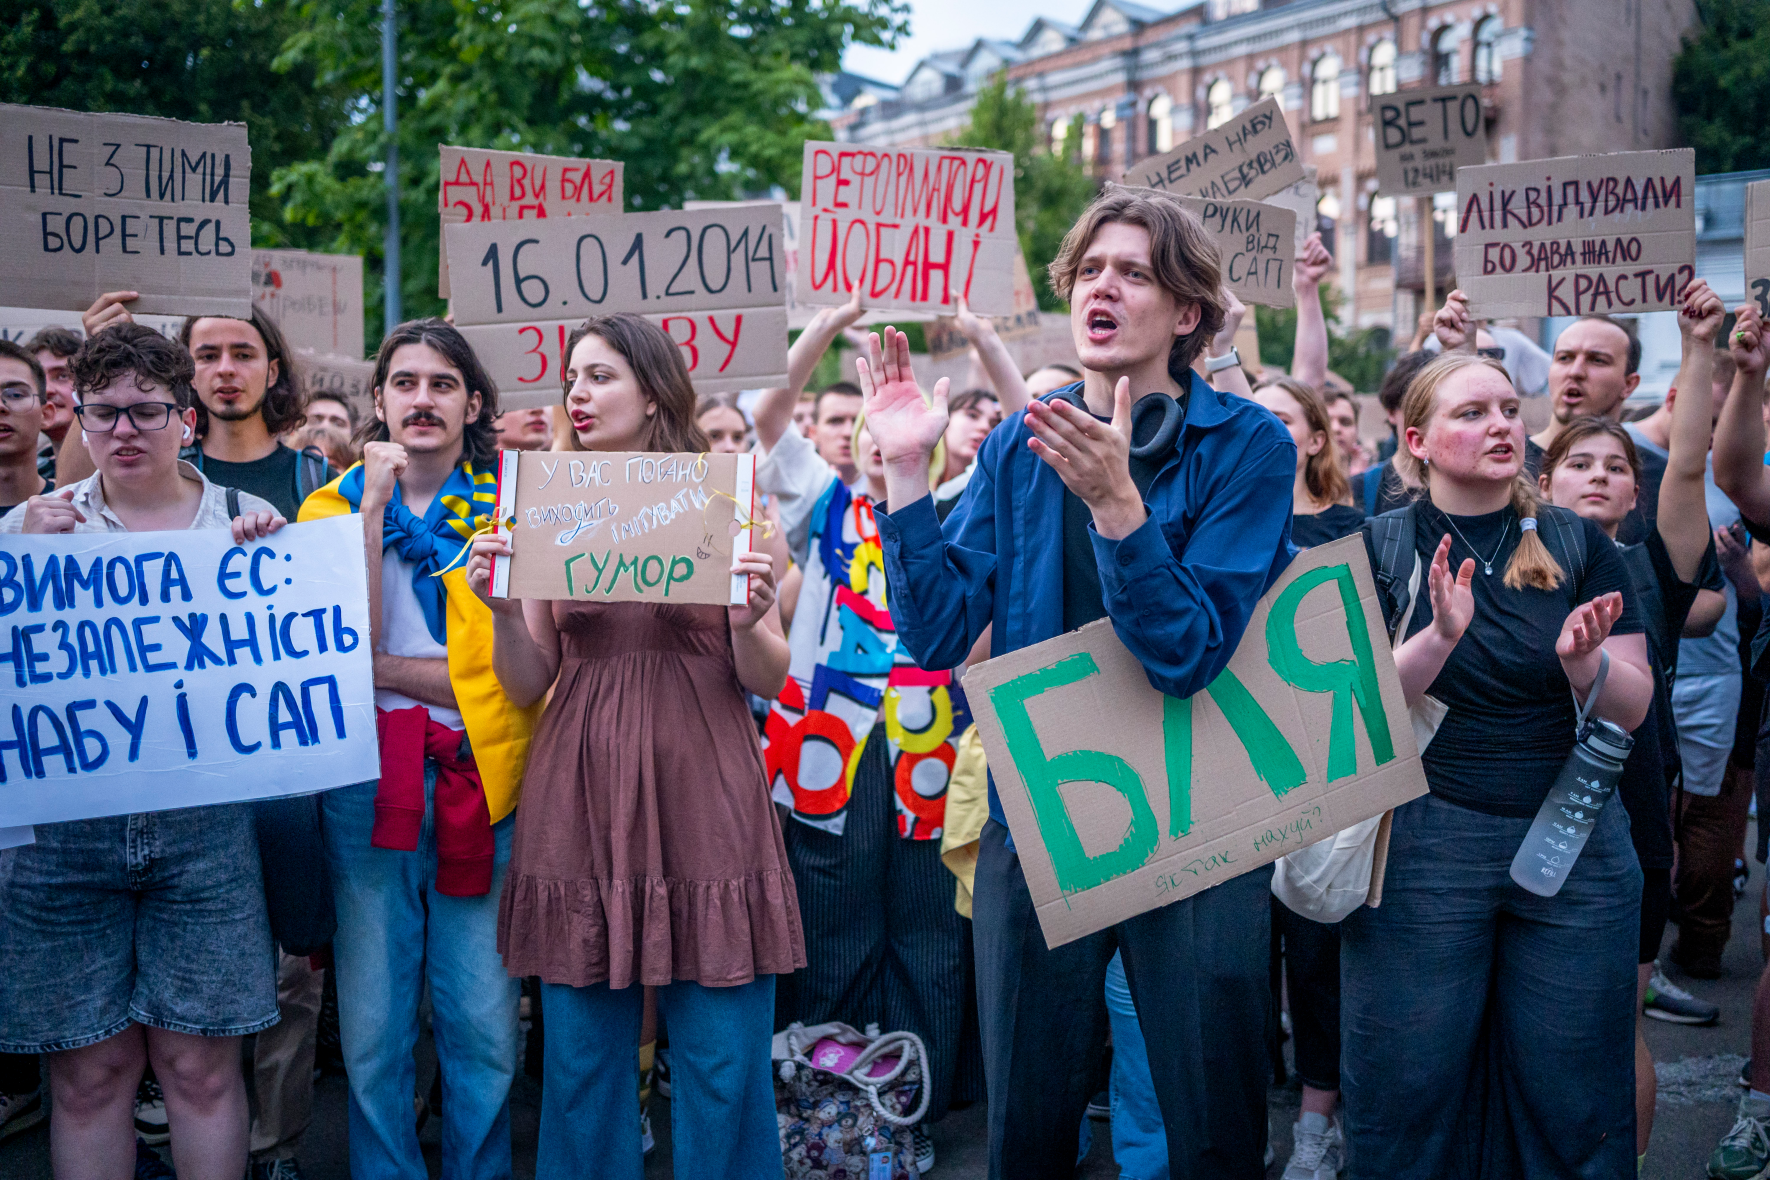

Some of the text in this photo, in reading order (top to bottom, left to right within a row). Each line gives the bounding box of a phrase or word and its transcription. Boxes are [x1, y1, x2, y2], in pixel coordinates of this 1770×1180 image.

[1225, 110, 1273, 152] НАБУ
[1381, 93, 1480, 152] ВЕТО
[28, 135, 82, 198] НЕ
[135, 144, 231, 205] ТИМИ
[444, 156, 615, 207] ДА ВИ БЛЯ
[811, 149, 1004, 233] РЕФОРМАТОРИ
[1203, 202, 1260, 235] РУКИ
[1459, 175, 1682, 234] ЛІКВІДУВАЛИ
[41, 212, 235, 257] БОРЕТЕСЬ
[810, 208, 981, 306] ЙОБАНІ
[1483, 242, 1518, 275] БО
[480, 223, 779, 314] 16.01.2014
[1228, 252, 1284, 289] САП
[1547, 264, 1695, 317] КРАСТИ?
[517, 314, 743, 383] ЗВУ
[538, 459, 559, 490] У
[568, 460, 611, 488] ВАС
[626, 455, 709, 483] ПОГАНО
[0, 546, 292, 617] ВИМОГА ЄС:
[565, 549, 694, 597] ГУМОР
[0, 695, 149, 783] НАБУ
[225, 674, 347, 755] САП
[986, 561, 1396, 903] БЛЯ
[1254, 806, 1323, 852] нахуй?
